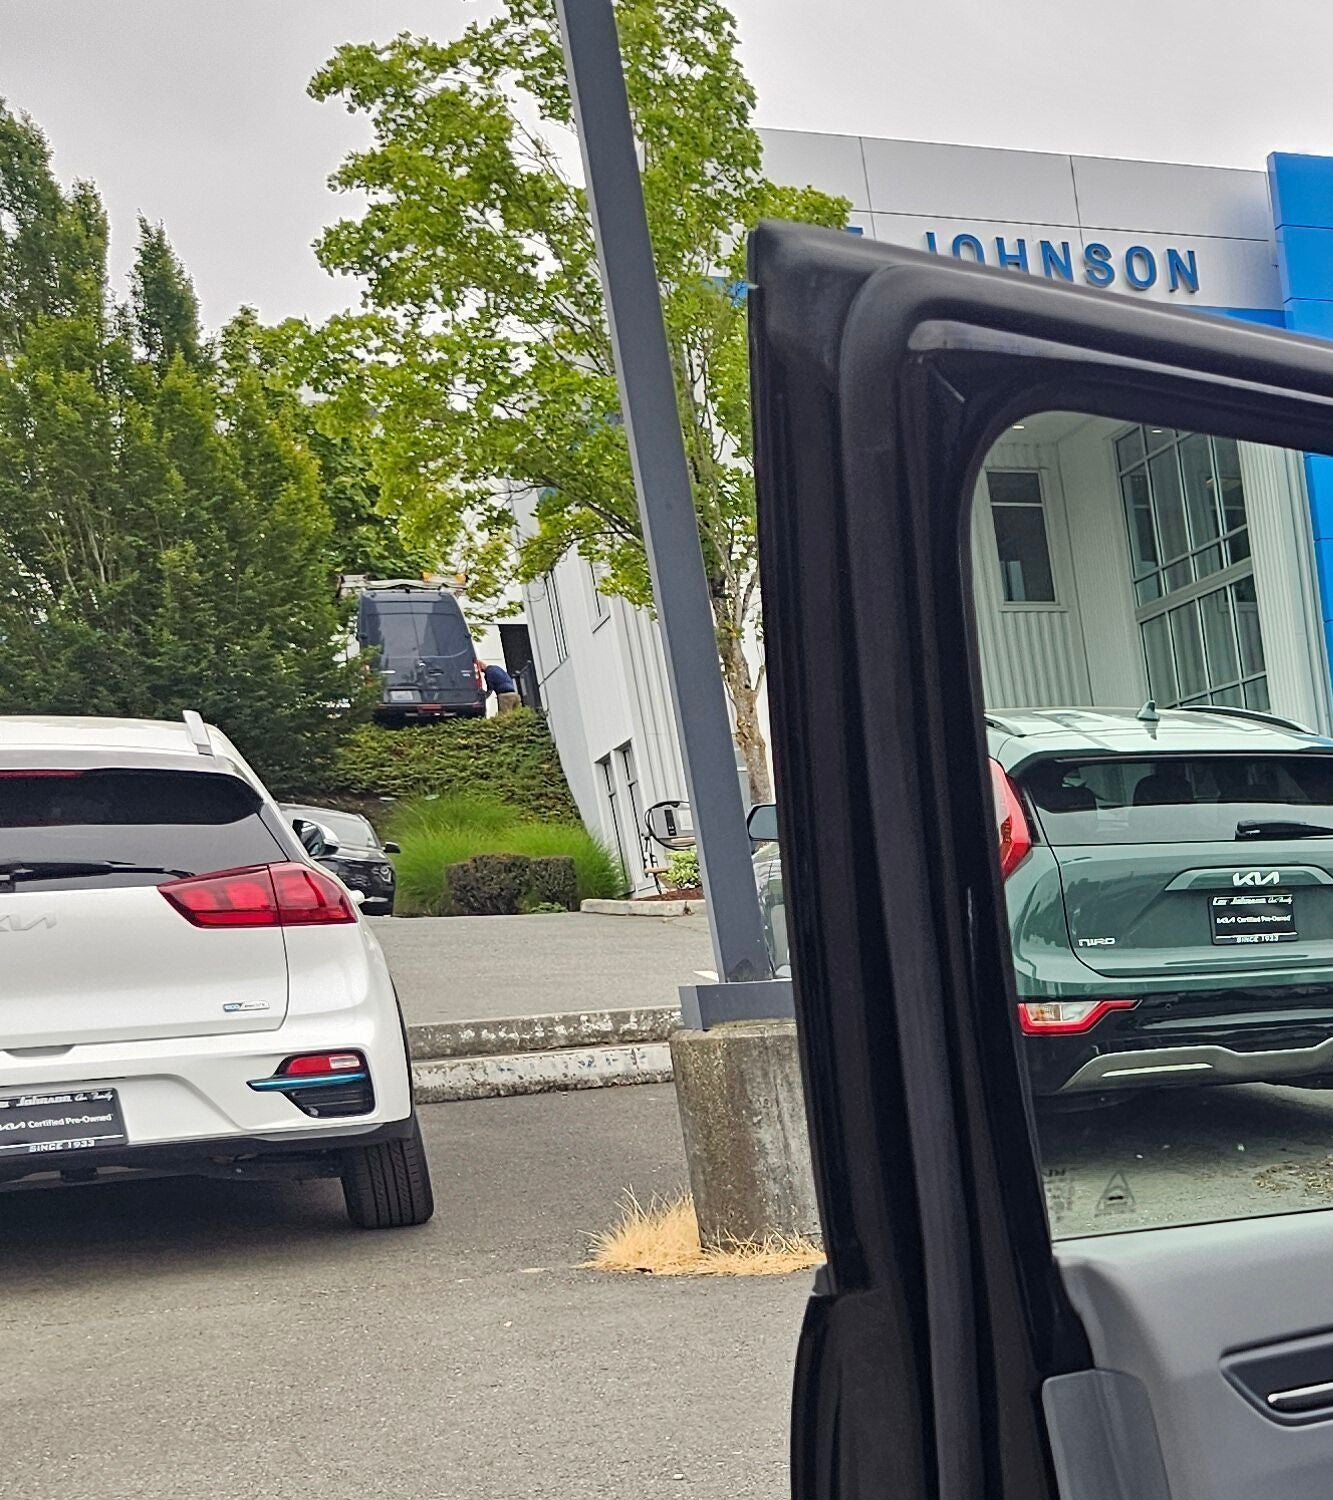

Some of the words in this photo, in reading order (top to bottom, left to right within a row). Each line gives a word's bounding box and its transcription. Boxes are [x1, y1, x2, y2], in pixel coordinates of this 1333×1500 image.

[1232, 871, 1280, 887] KIA
[0, 911, 58, 932] IA
[28, 1117, 65, 1129] Certified
[65, 1113, 113, 1125] Pre-Owned
[28, 1143, 64, 1153] SINCE
[67, 1139, 96, 1149] 1933
